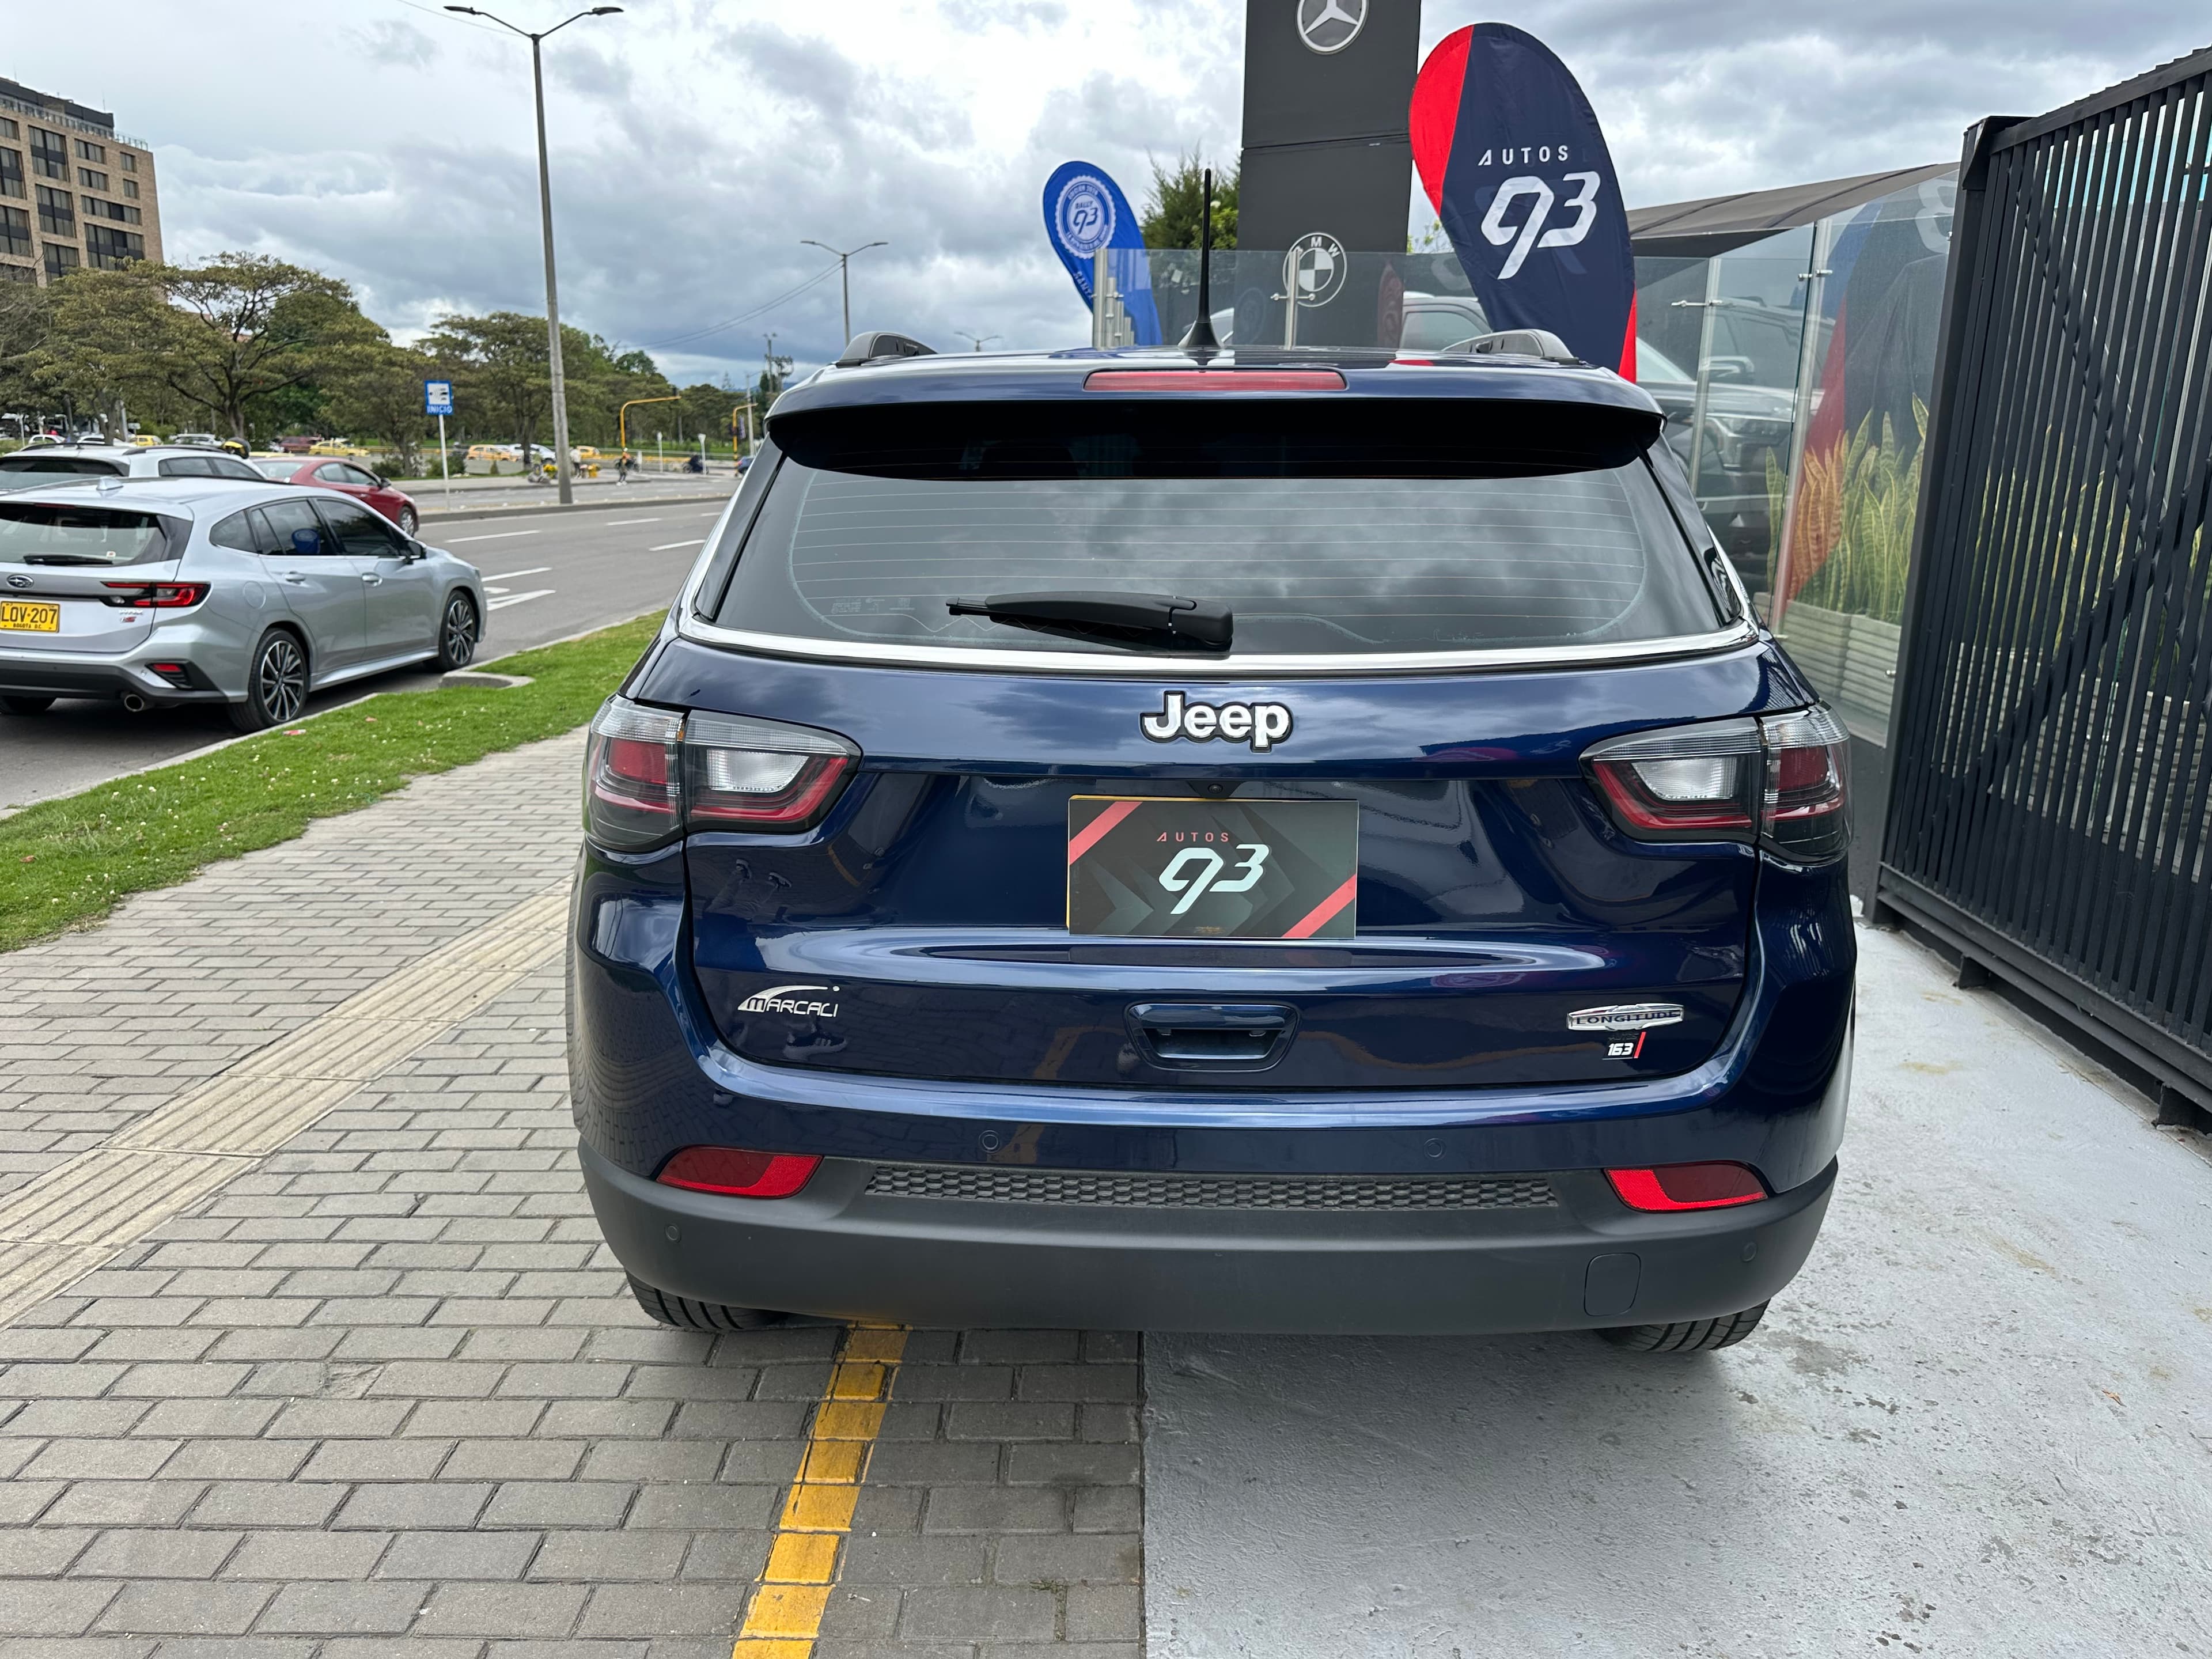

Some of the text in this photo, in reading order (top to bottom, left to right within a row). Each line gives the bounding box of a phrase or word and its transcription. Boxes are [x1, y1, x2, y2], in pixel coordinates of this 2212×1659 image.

[1478, 145, 1569, 166] AUTOS
[1073, 207, 1098, 235] 93
[1481, 171, 1601, 280] 93
[427, 405, 453, 414] INICIO
[1143, 693, 1291, 749] Jeep
[1157, 832, 1229, 842] AUTOS
[1158, 844, 1270, 915] 93
[1577, 1011, 1681, 1025] LONGITUDE
[1607, 1042, 1634, 1056] 163
